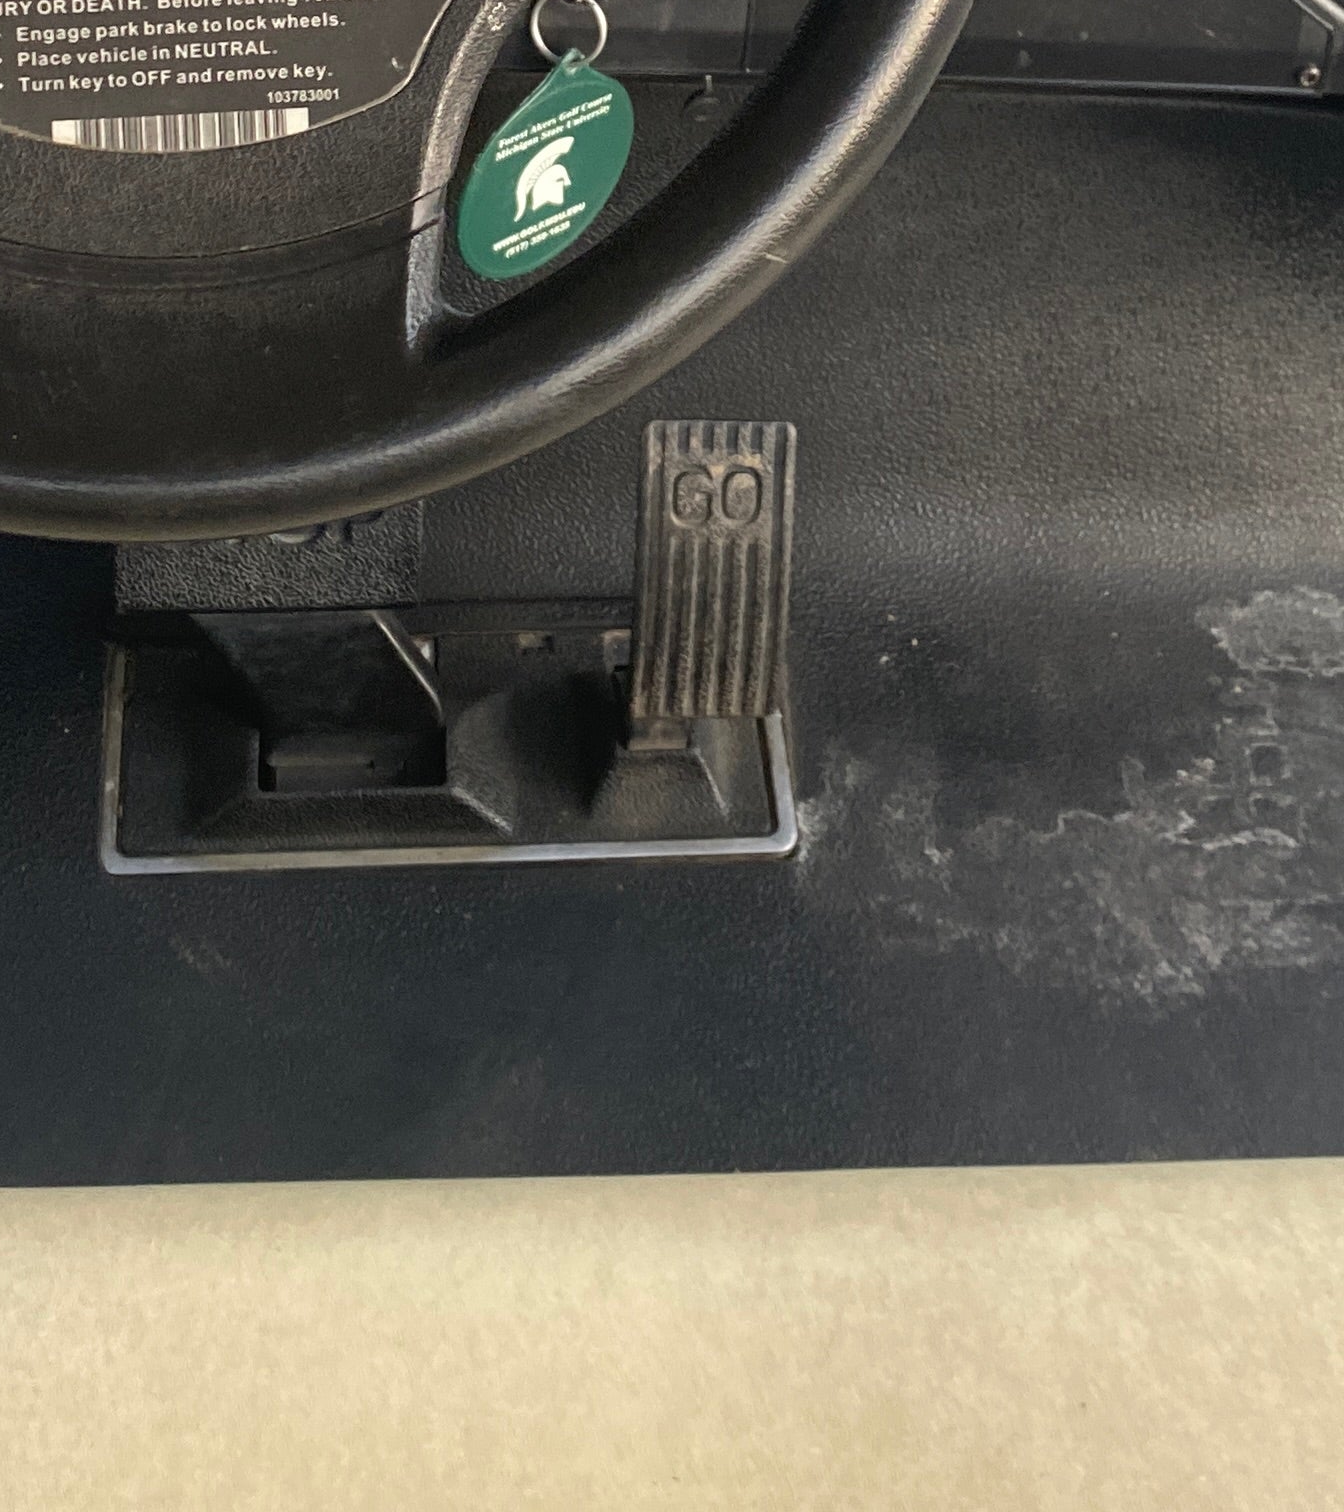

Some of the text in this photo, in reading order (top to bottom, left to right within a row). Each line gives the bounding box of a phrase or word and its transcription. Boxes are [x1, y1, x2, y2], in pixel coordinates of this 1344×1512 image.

[37, 0, 67, 15] OR
[16, 12, 345, 44] Engage park brake to lock wheels.
[17, 40, 277, 67] Place vehicle in NEUTRAL.
[18, 64, 332, 92] Turn key to OFF and remove key.
[267, 88, 339, 103] 103783001
[495, 104, 610, 162] Michigan State University
[498, 129, 528, 148] Forest
[530, 118, 556, 135] Akers
[558, 106, 581, 121] Golf
[671, 464, 763, 528] GO
